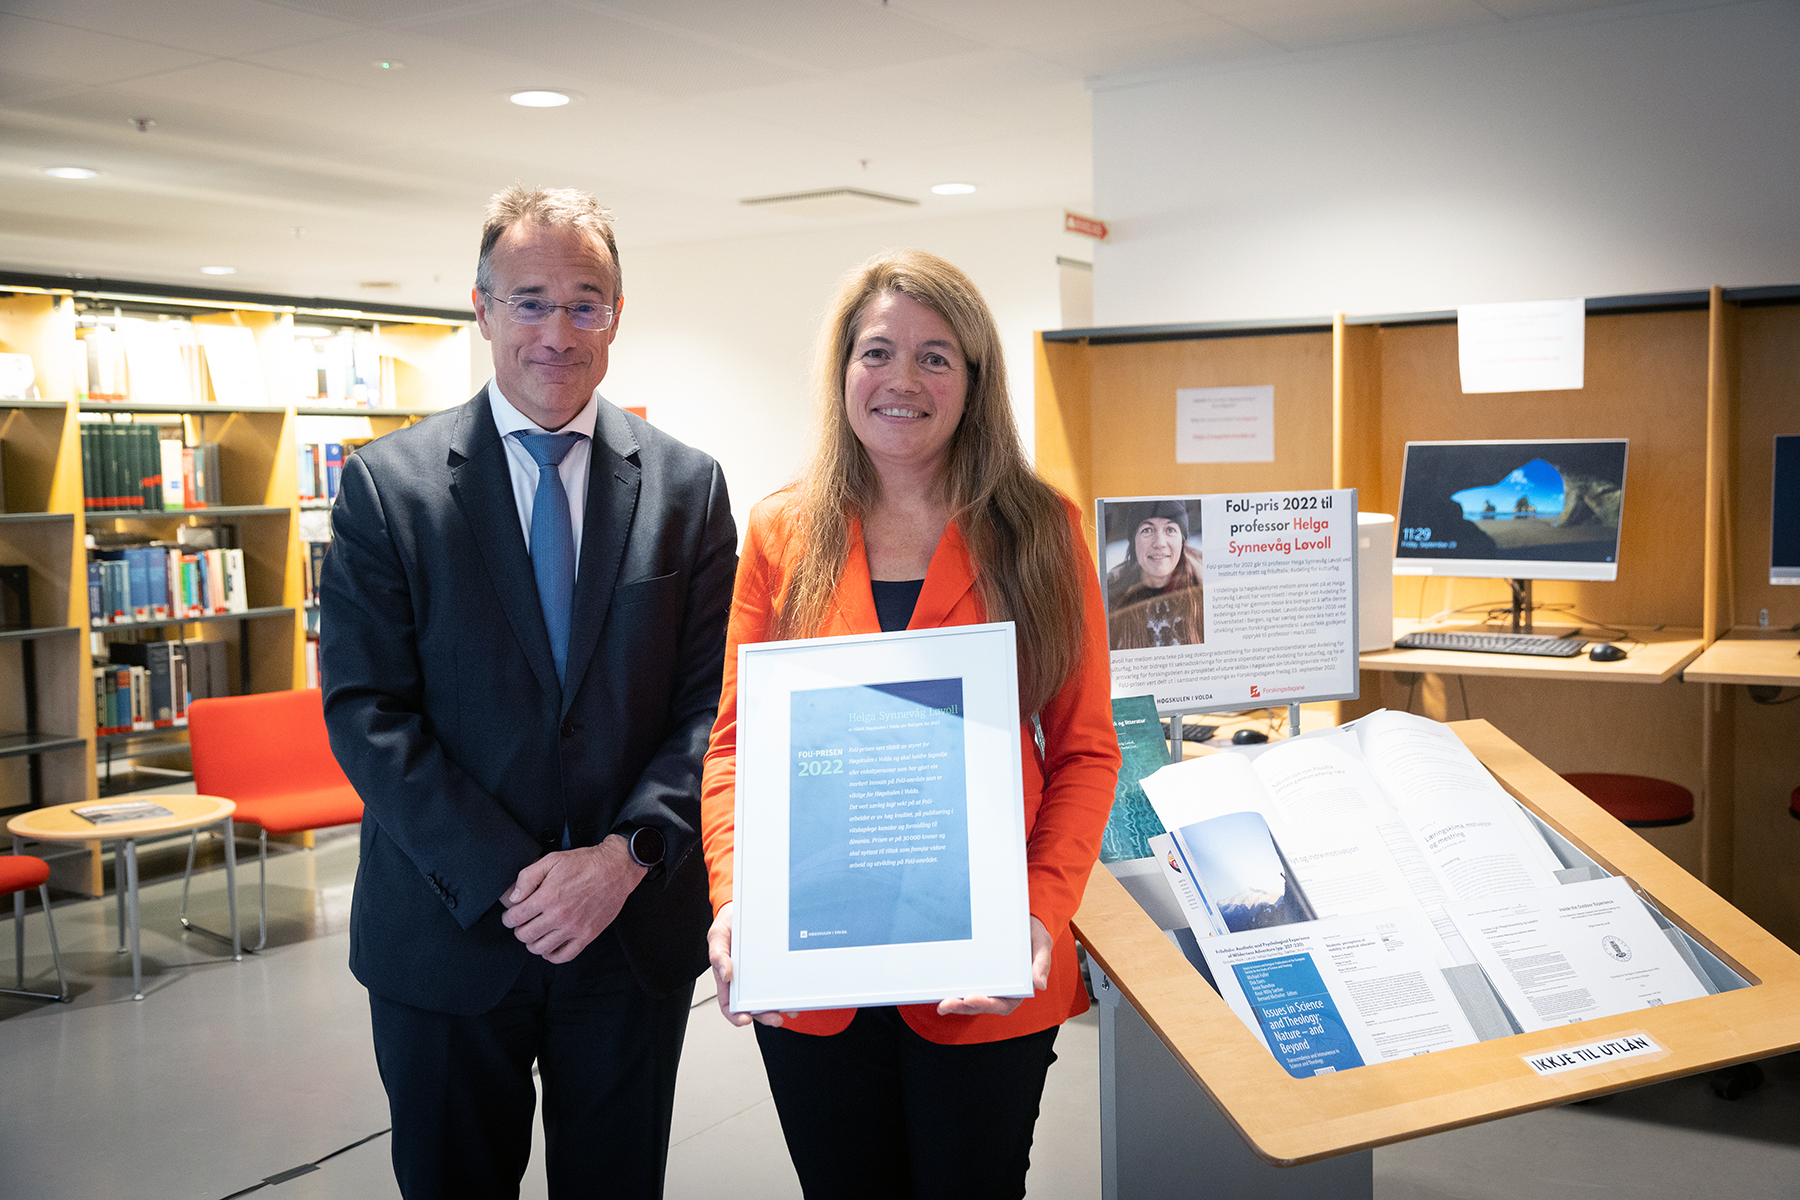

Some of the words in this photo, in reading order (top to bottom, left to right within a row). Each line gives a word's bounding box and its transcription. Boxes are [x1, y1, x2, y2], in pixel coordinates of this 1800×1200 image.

[1226, 499, 1279, 515] FoU-pris
[1283, 497, 1317, 510] 2022
[1321, 496, 1332, 509] til
[1230, 519, 1290, 536] professor
[1293, 517, 1328, 533] Helga
[1403, 527, 1432, 541] 11:29
[1229, 538, 1290, 556] Synnevåg
[1295, 536, 1331, 550] Løvoll
[1263, 685, 1304, 694] Forskingsdagane
[849, 712, 876, 723] Helga
[879, 708, 926, 722] Synnevåg
[929, 705, 958, 716] Løvoll
[798, 749, 843, 758] FOU-PRISEN
[798, 760, 843, 776] 2022
[1438, 832, 1465, 844] mestring
[1325, 846, 1359, 857] motivasjon
[1262, 1006, 1287, 1018] Issues
[1286, 1004, 1296, 1014] in
[1295, 1000, 1324, 1012] Science
[1269, 1018, 1285, 1030] and
[1283, 1014, 1322, 1027] Theology:
[1274, 1030, 1301, 1042] Nature
[1309, 1023, 1324, 1035] and
[1280, 1039, 1310, 1054] Beyond
[1531, 1053, 1576, 1071] IKKJE
[1572, 1049, 1601, 1061] TIL
[1598, 1037, 1650, 1056] UTLÅN
